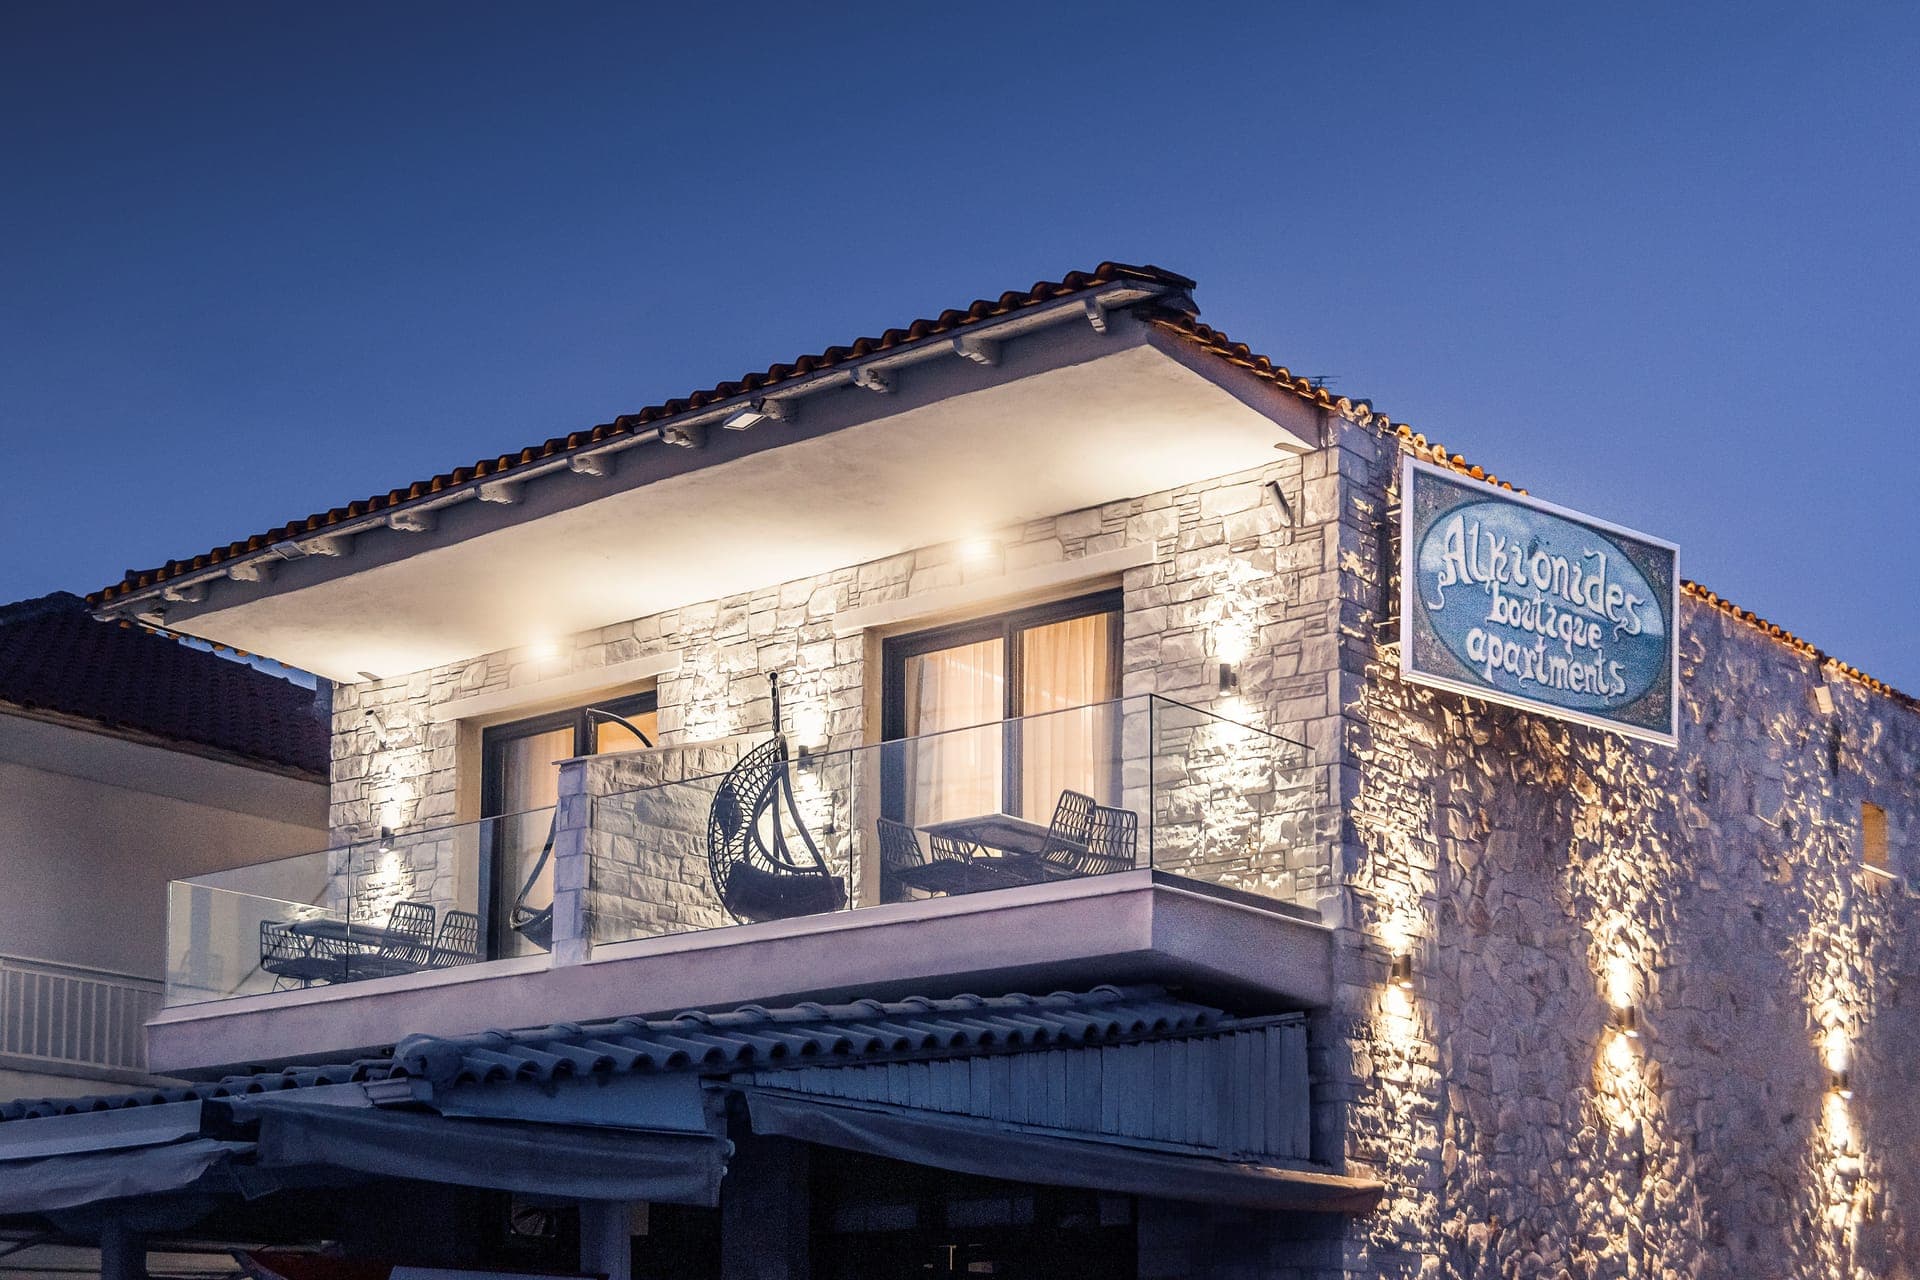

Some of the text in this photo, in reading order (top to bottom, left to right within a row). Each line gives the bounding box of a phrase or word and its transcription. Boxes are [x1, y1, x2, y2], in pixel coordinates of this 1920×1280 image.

[1428, 516, 1644, 639] Alkionides
[1487, 583, 1602, 660] boutique
[1466, 628, 1626, 698] apartments
